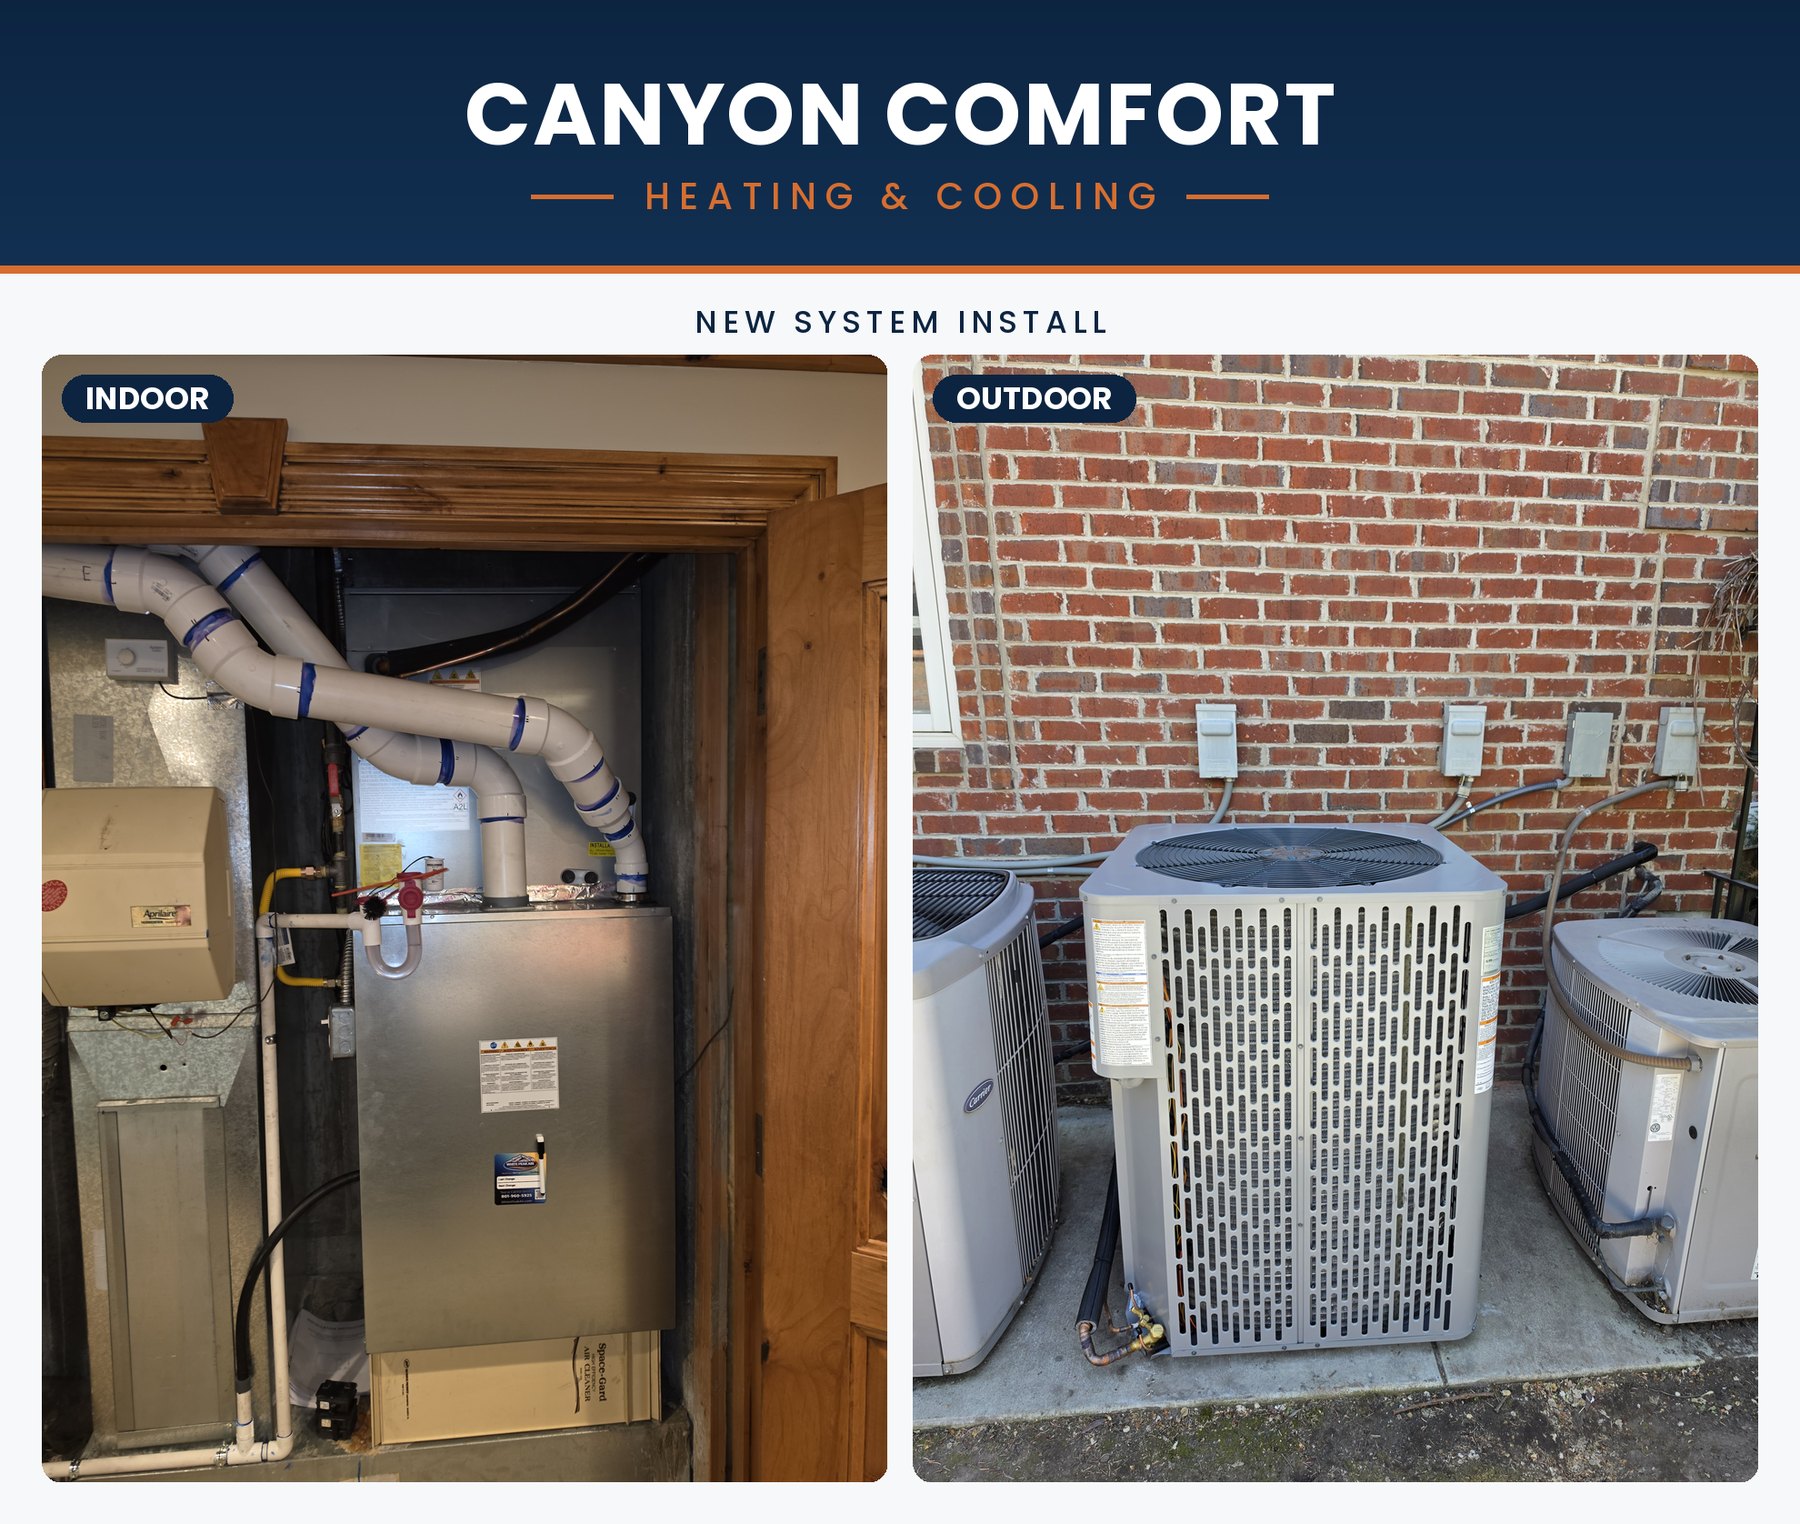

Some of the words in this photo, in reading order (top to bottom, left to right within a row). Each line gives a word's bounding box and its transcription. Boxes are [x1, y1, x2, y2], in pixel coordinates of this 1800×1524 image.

[82, 565, 91, 581] E
[143, 908, 177, 919] Aprilaire
[969, 1084, 992, 1108] Carrier
[583, 1346, 591, 1361] AIR
[584, 1363, 592, 1402] CLEANER
